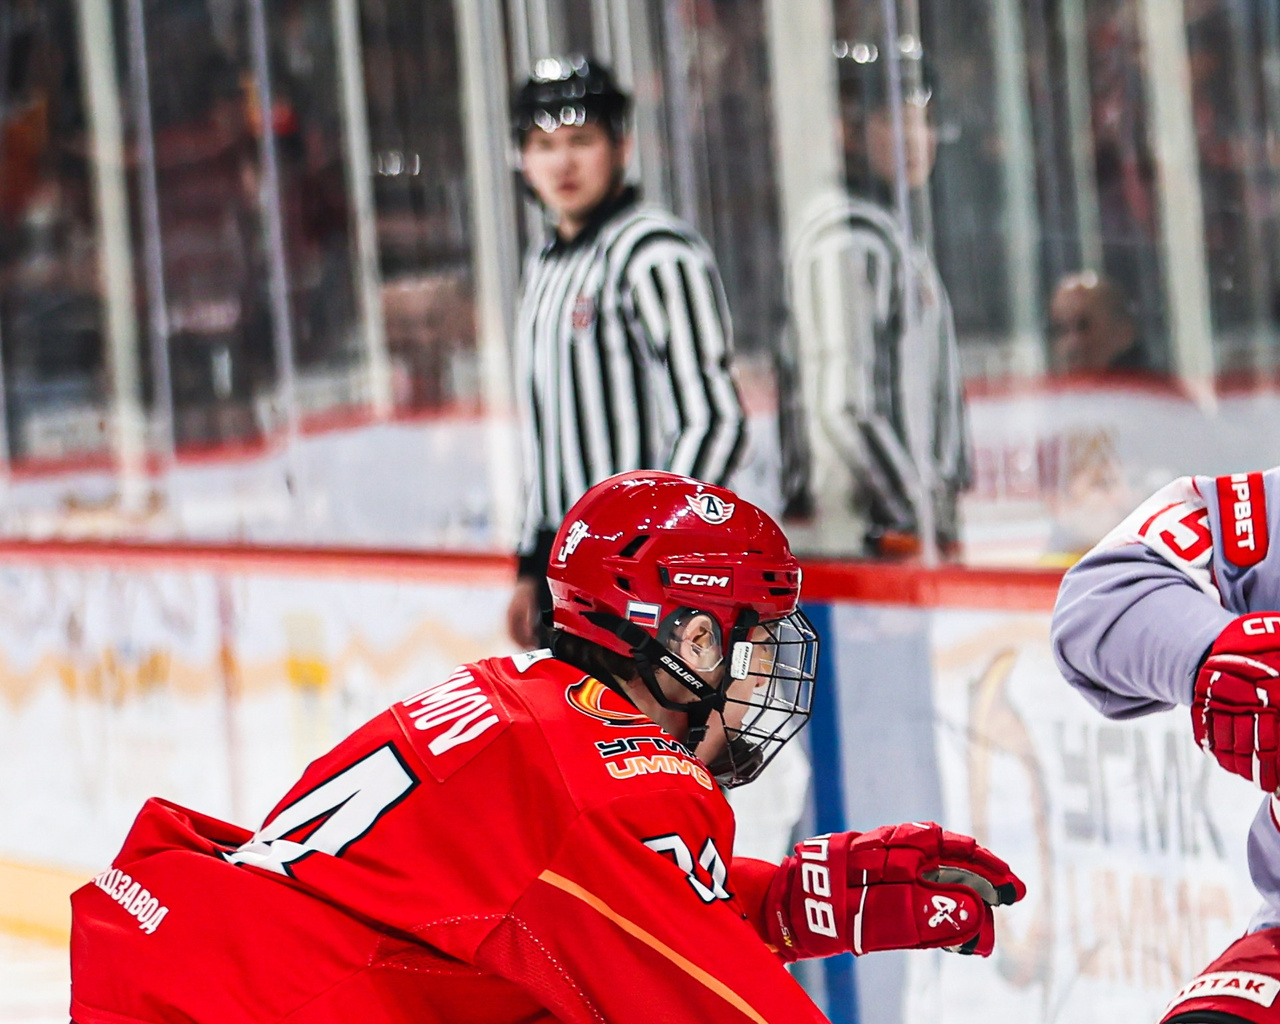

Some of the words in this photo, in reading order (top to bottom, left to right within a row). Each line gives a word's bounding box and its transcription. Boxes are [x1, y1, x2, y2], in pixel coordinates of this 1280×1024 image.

[672, 572, 730, 588] CCM
[403, 665, 500, 756] MOV
[92, 866, 170, 935] ШЗАВОД
